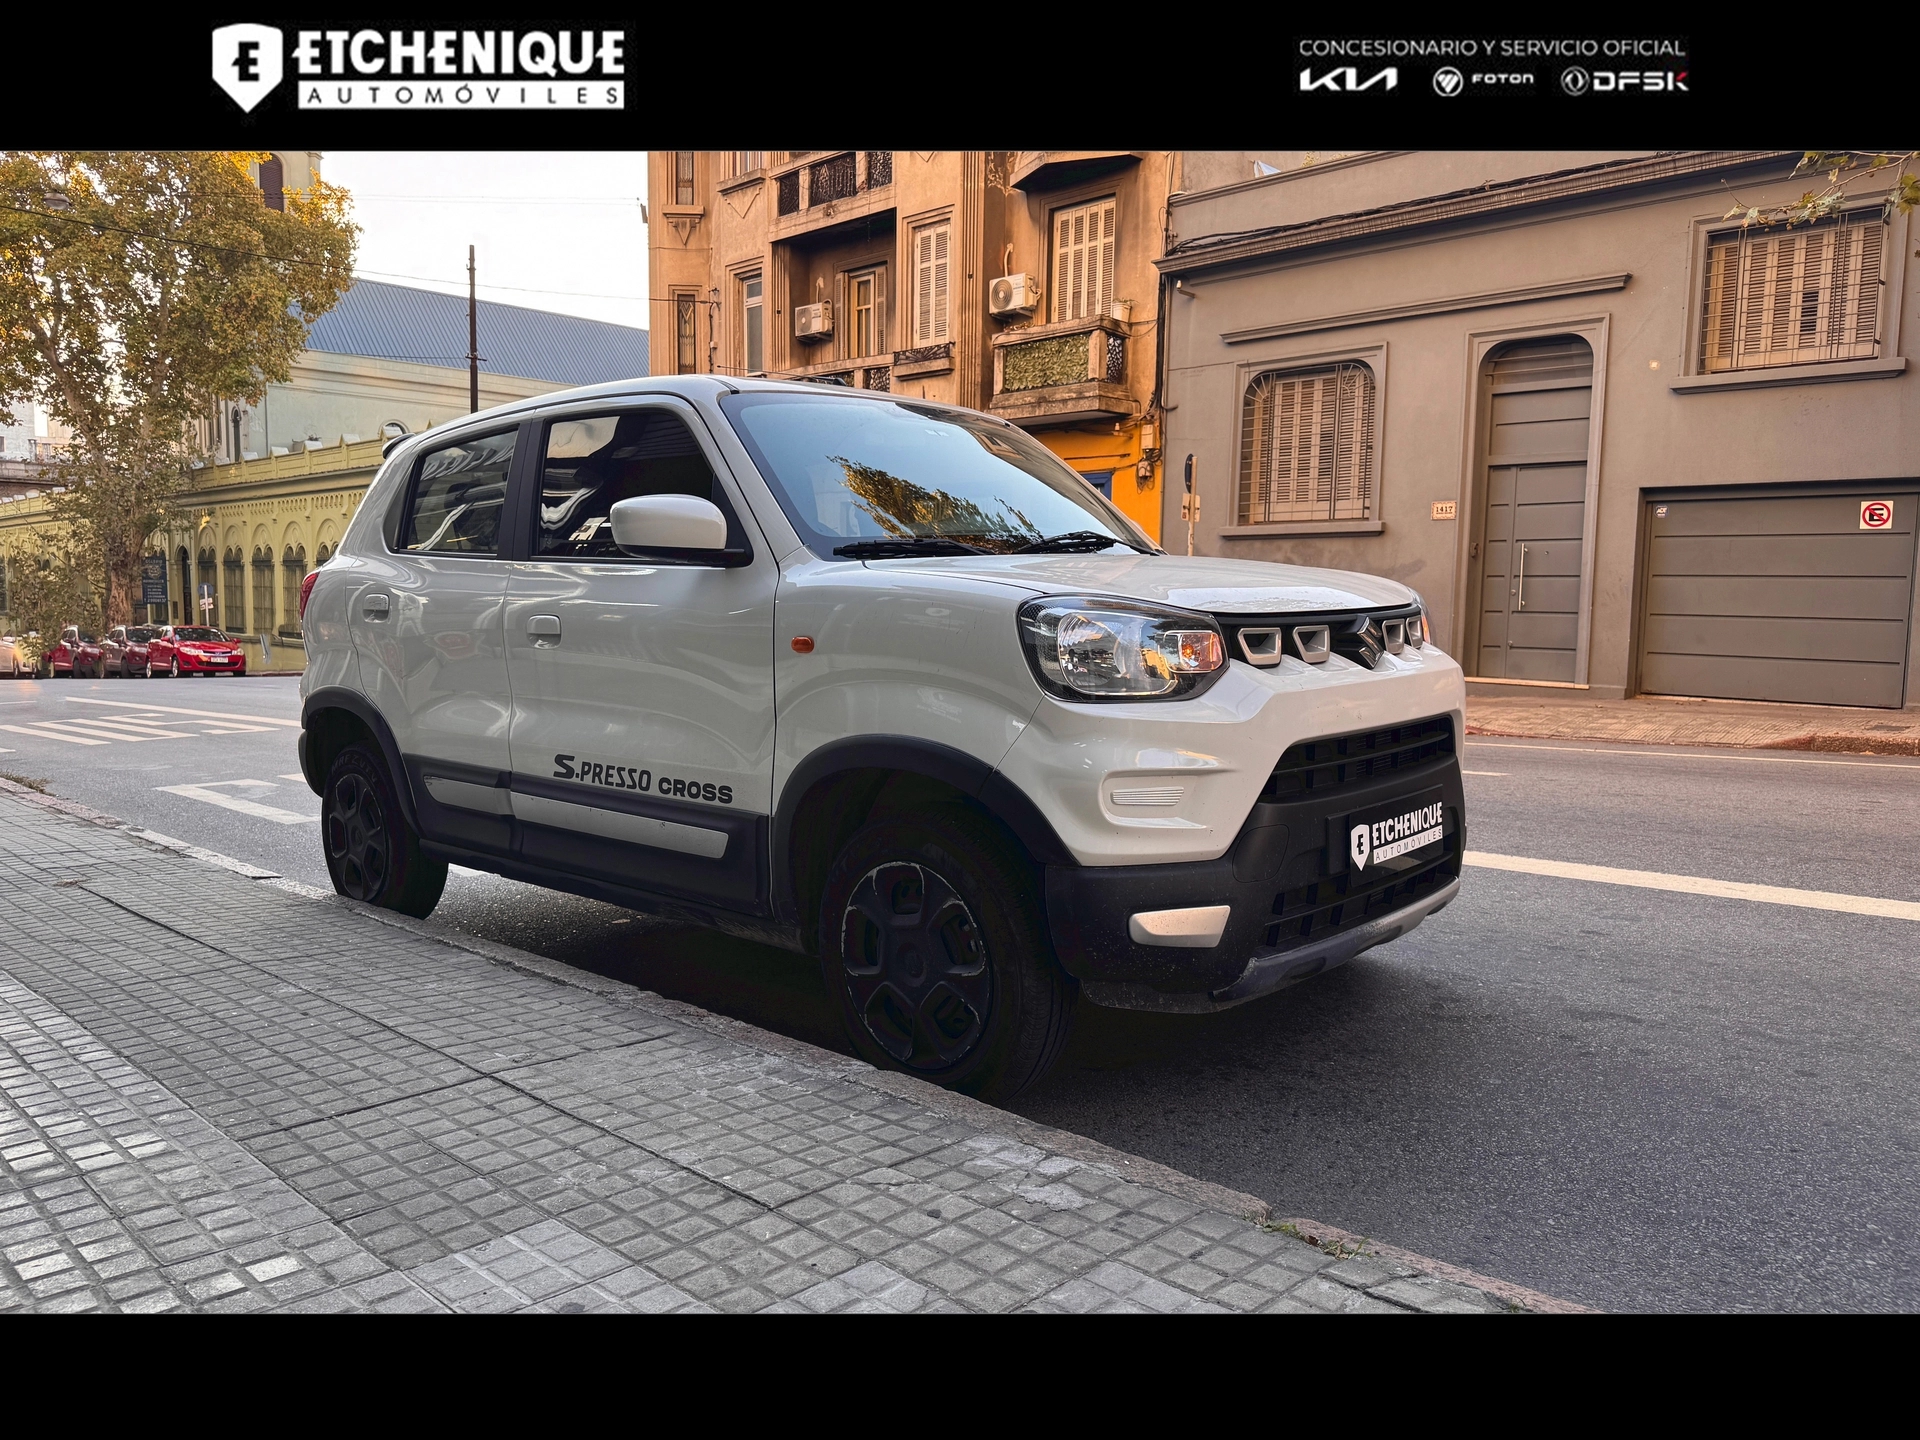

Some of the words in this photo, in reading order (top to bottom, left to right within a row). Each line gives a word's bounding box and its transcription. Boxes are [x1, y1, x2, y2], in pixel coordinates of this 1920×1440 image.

[553, 753, 652, 792] S.PRESSO
[658, 777, 733, 804] CROSS
[1372, 801, 1442, 847] ETCHENIQUE
